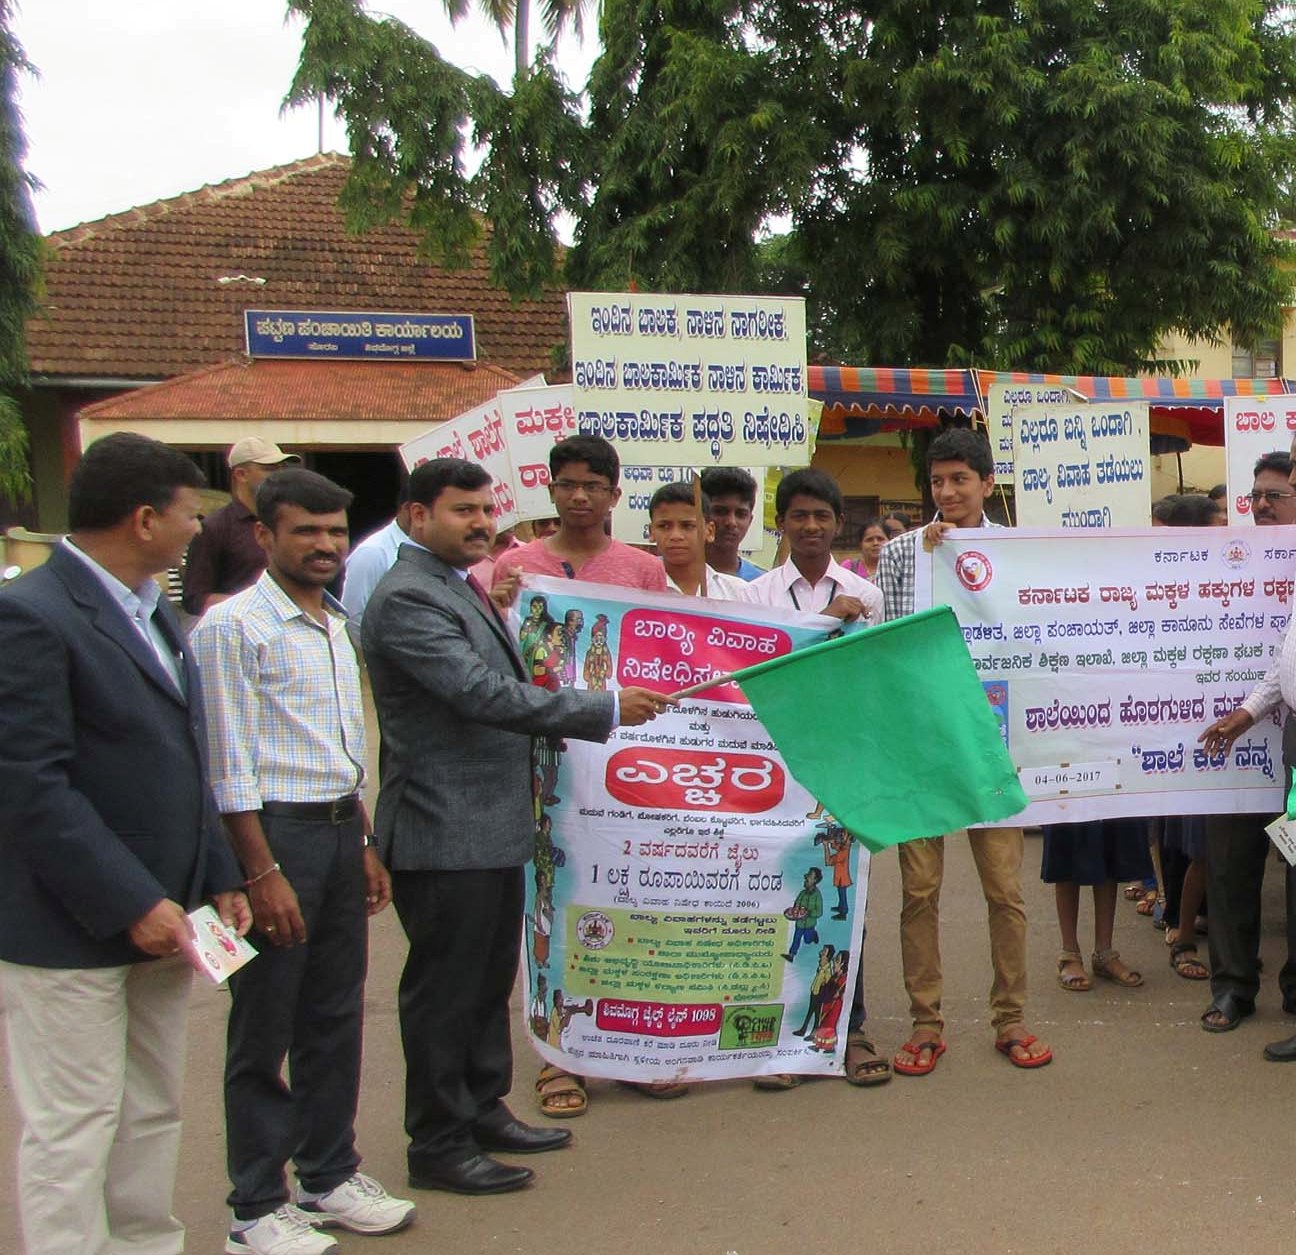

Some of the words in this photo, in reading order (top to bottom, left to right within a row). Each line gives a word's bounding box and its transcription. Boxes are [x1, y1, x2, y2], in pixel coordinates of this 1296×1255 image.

[257, 317, 295, 343] ಪಟ್ಟಣ
[298, 318, 373, 338] ಪಂಚಾಯಿತಿ
[375, 320, 464, 340] ಕಾರ್ಯಾಲಯ
[591, 302, 632, 336] ಇಂದಿನ
[638, 302, 682, 340] ಬಾಲಕ,
[686, 303, 725, 338] ನಾಳಿನ
[575, 355, 616, 389] ಇಂದಿನ
[622, 355, 702, 391] ಬಾಲಕಾರ್ಮಿಕ
[708, 356, 746, 391] ನಾಳಿನ
[578, 405, 684, 441] ಬಾಲಕಾರ್ಮಿಕ
[742, 405, 806, 448] ನಿಷೇಧಿಸಿ
[1020, 413, 1059, 453] ಎಲ್ಲರೂ
[1064, 414, 1088, 451] ಬನ್ನಿ
[1235, 408, 1275, 432] ಬಾಲ
[1023, 463, 1053, 504] ಬಾಲ್ಯ
[1057, 458, 1091, 488] ವಿವಾಹ
[1096, 453, 1143, 484] ತಡೆಯಲು
[1154, 549, 1209, 563] ಕರ್ನಾಟಕ
[1018, 582, 1090, 605] ಕರ್ನಾಟಕ
[1099, 584, 1138, 611] ರಾಜ್ಯ
[1145, 580, 1190, 609] ಮಕ್ಕಳ
[1198, 578, 1255, 607] ಹಕ್ಕುಗಳ
[634, 620, 696, 656] ಬಾಲ್ಯ
[707, 627, 778, 654] ವಿವಾಹ
[1013, 624, 1042, 644] ಜಿಲ್ಲಾ
[1128, 620, 1156, 639] ಜಿಲ್ಲಾ
[1161, 614, 1213, 632] ಕಾನೂನು
[1219, 612, 1265, 630] ಸೇವೆಗಳ
[1038, 653, 1070, 673] ಶಿಕ್ಷಣ
[1121, 650, 1148, 670] ಜಿಲ್ಲಾ
[1153, 646, 1187, 669] ಮಕ್ಕಳ
[1192, 644, 1229, 666] ರಕ್ಷಣಾ
[1234, 642, 1263, 660] ಘಟಕ
[1195, 669, 1221, 685] ಇವರ
[1025, 697, 1112, 731] ಶಾಲೆಯಿಂದ
[1119, 692, 1206, 726] ಹೊರಗುಳಿದ
[689, 722, 711, 735] ಮತ್ತು
[1235, 738, 1275, 779] ನನ್ನ
[616, 757, 774, 806] ಎಚ್ಚರ
[1035, 771, 1101, 785] 04-06-2017
[623, 840, 632, 856] 2
[639, 841, 720, 859] ವರ್ಷದವರೆಗೆ
[727, 843, 760, 868] ಜೈಲು
[592, 864, 599, 884] 1
[607, 865, 630, 898] ಲಕ್ಷ
[638, 866, 741, 891] ರೂಪಾಯಿವರೆಗೆ
[748, 869, 784, 892] ದಂಡ
[737, 901, 760, 909] 2006)
[603, 1003, 640, 1026] ಶಿವಮೊಗ್ಗ
[691, 1008, 716, 1022] 1098
